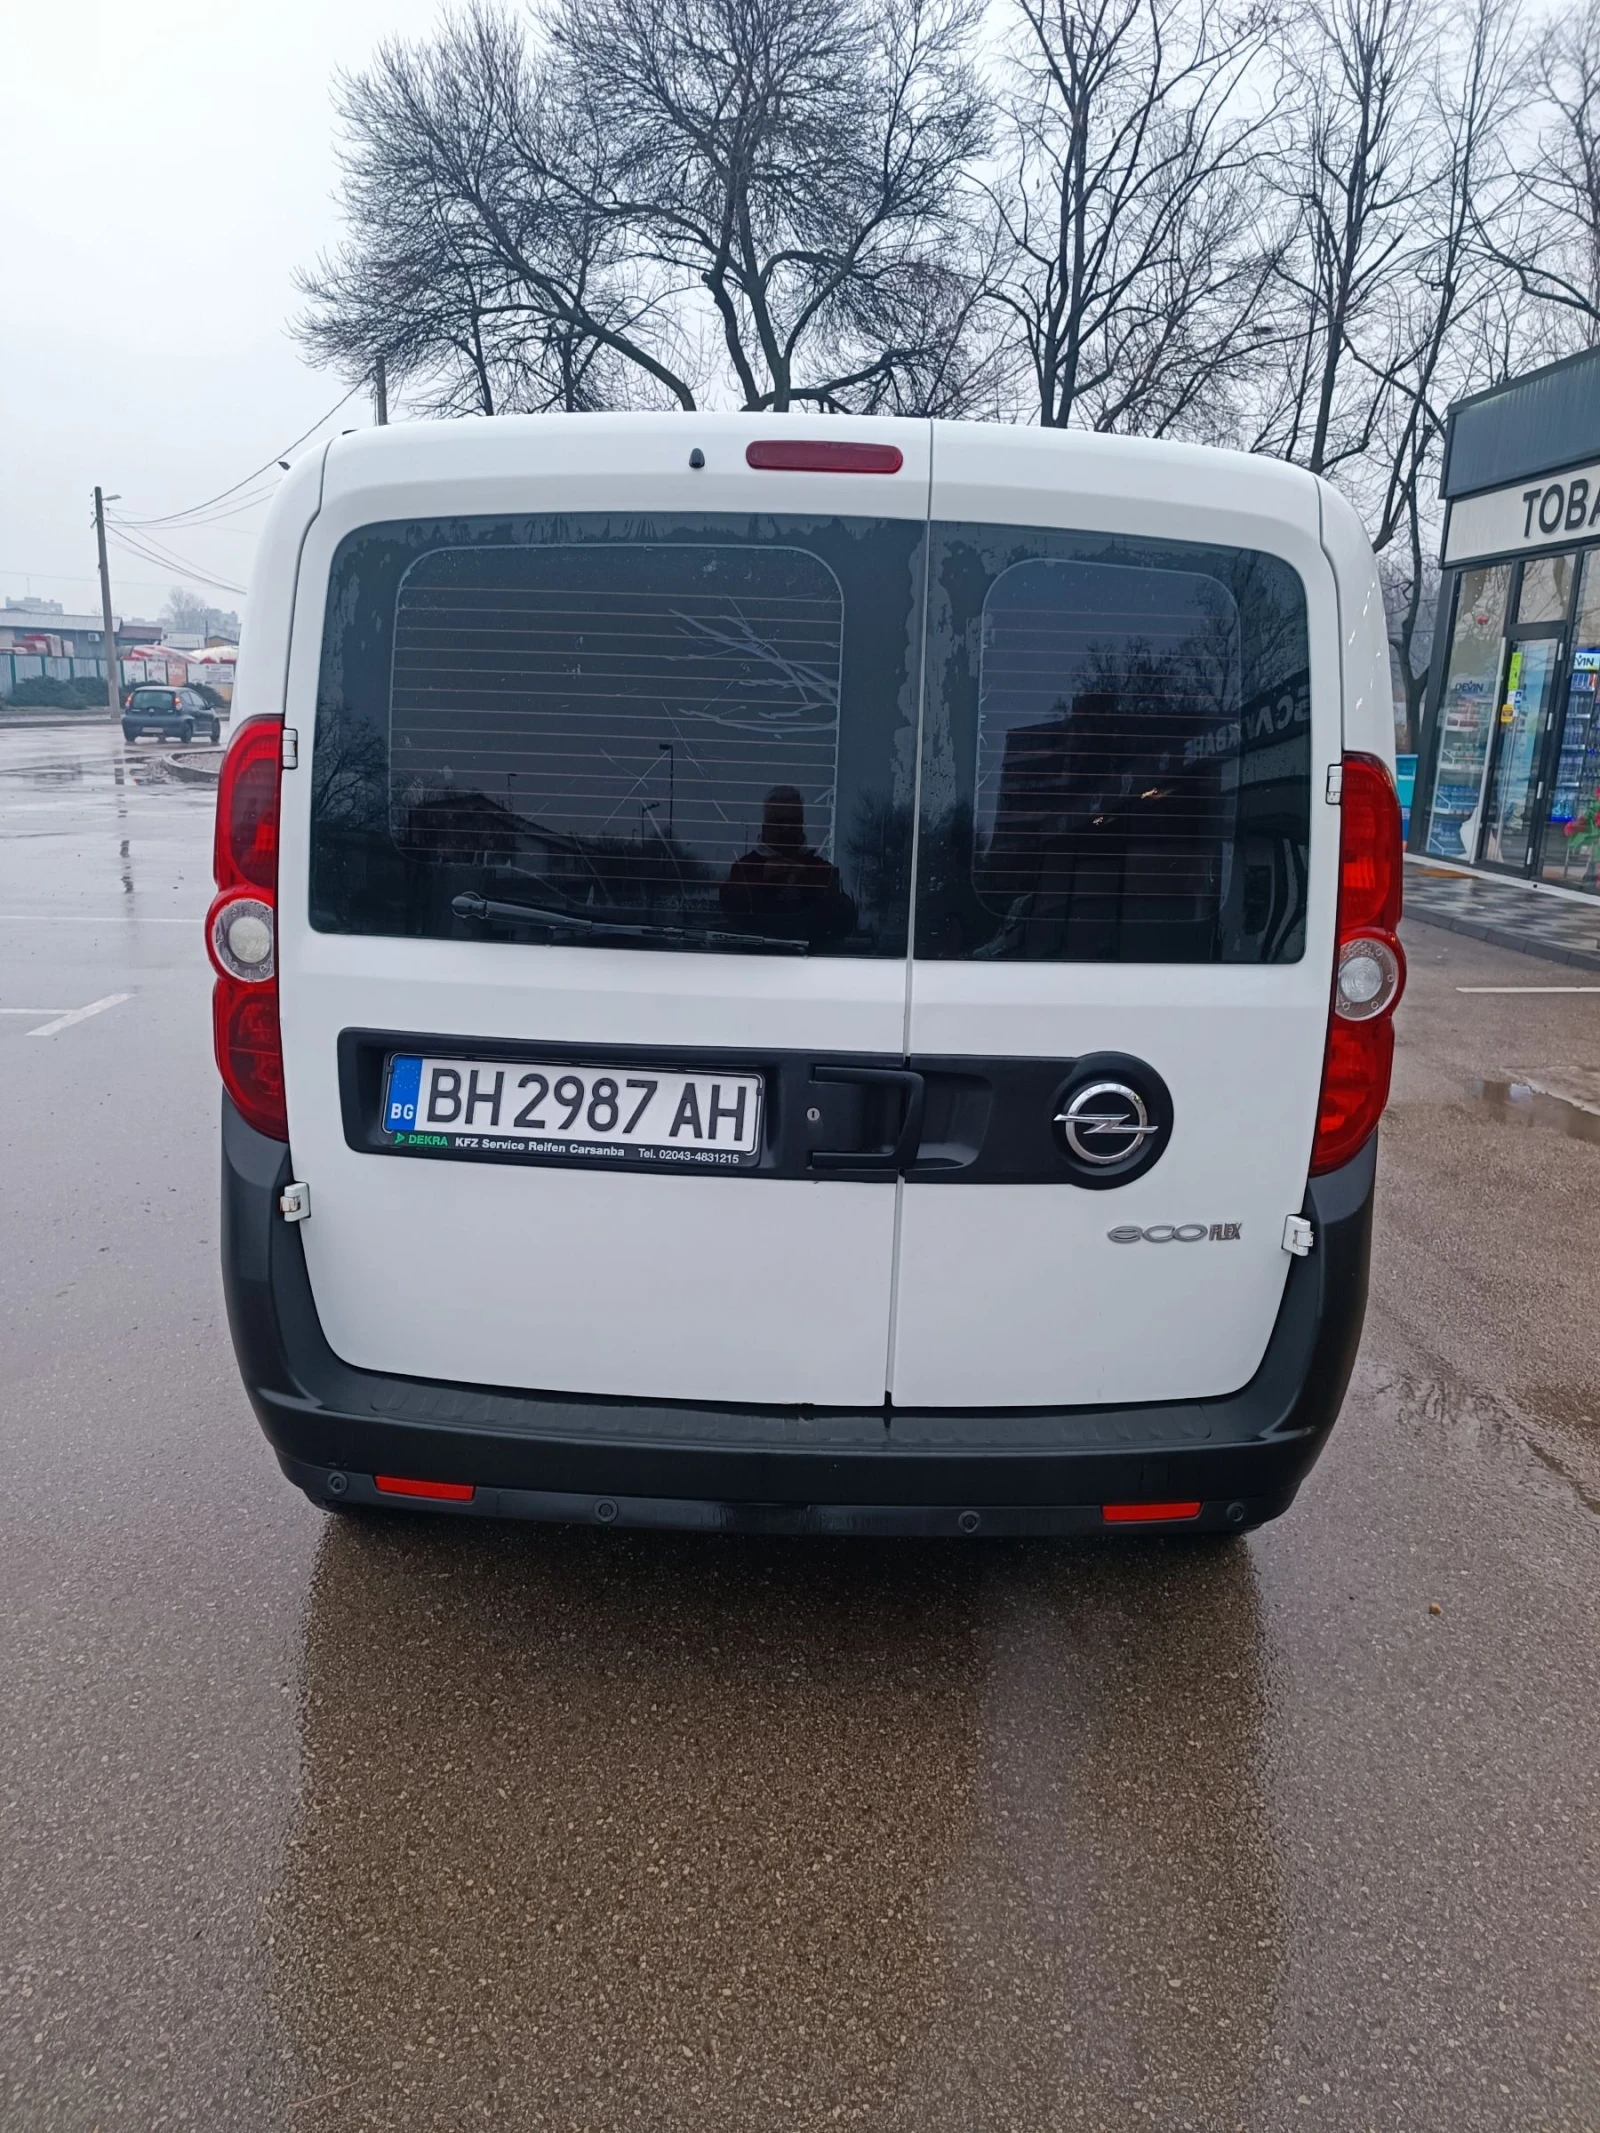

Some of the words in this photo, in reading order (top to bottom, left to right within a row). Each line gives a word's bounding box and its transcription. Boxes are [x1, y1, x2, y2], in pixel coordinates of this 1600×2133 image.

[1455, 680, 1484, 691] DEVIN
[391, 1102, 414, 1120] BG
[427, 1068, 505, 1126] BH
[513, 1073, 659, 1134] 2987
[669, 1082, 747, 1141] AH
[408, 1134, 448, 1146] DEKRA
[455, 1137, 479, 1148] KFZ
[482, 1140, 525, 1151] Service
[528, 1142, 566, 1154] Reifen
[569, 1144, 625, 1157] Carsanba
[638, 1148, 656, 1159] Tel.
[659, 1150, 739, 1164] 02043-4831215
